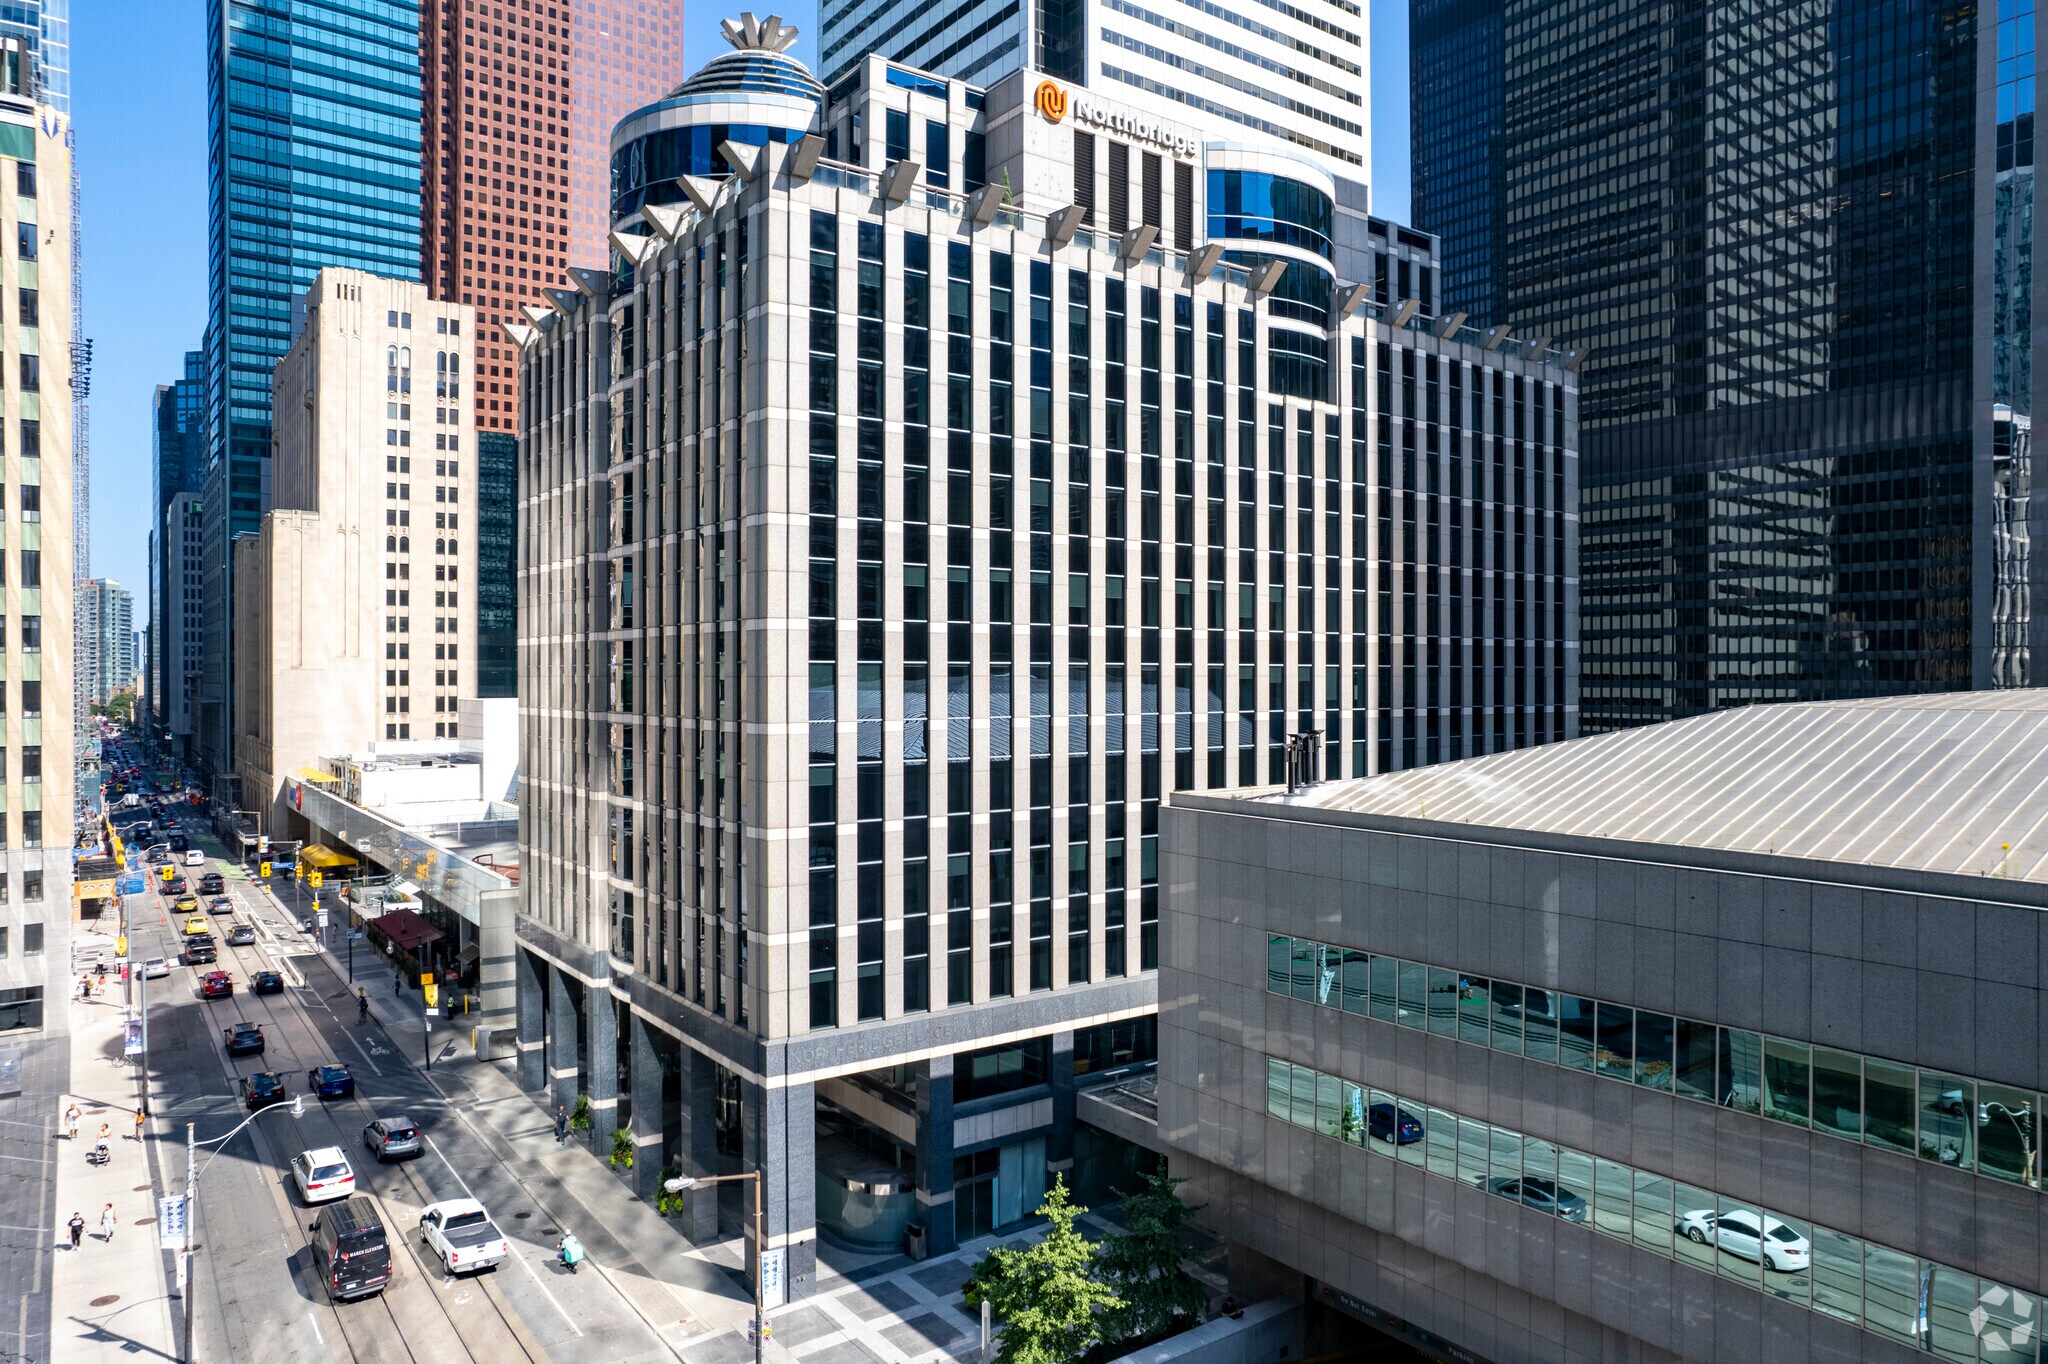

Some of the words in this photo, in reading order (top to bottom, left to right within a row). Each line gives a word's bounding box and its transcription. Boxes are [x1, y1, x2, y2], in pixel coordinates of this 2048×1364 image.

[1076, 97, 1196, 155] Northbridge
[1340, 1295, 1349, 1304] Do
[1349, 1300, 1360, 1310] Not
[1361, 1305, 1377, 1318] Enter
